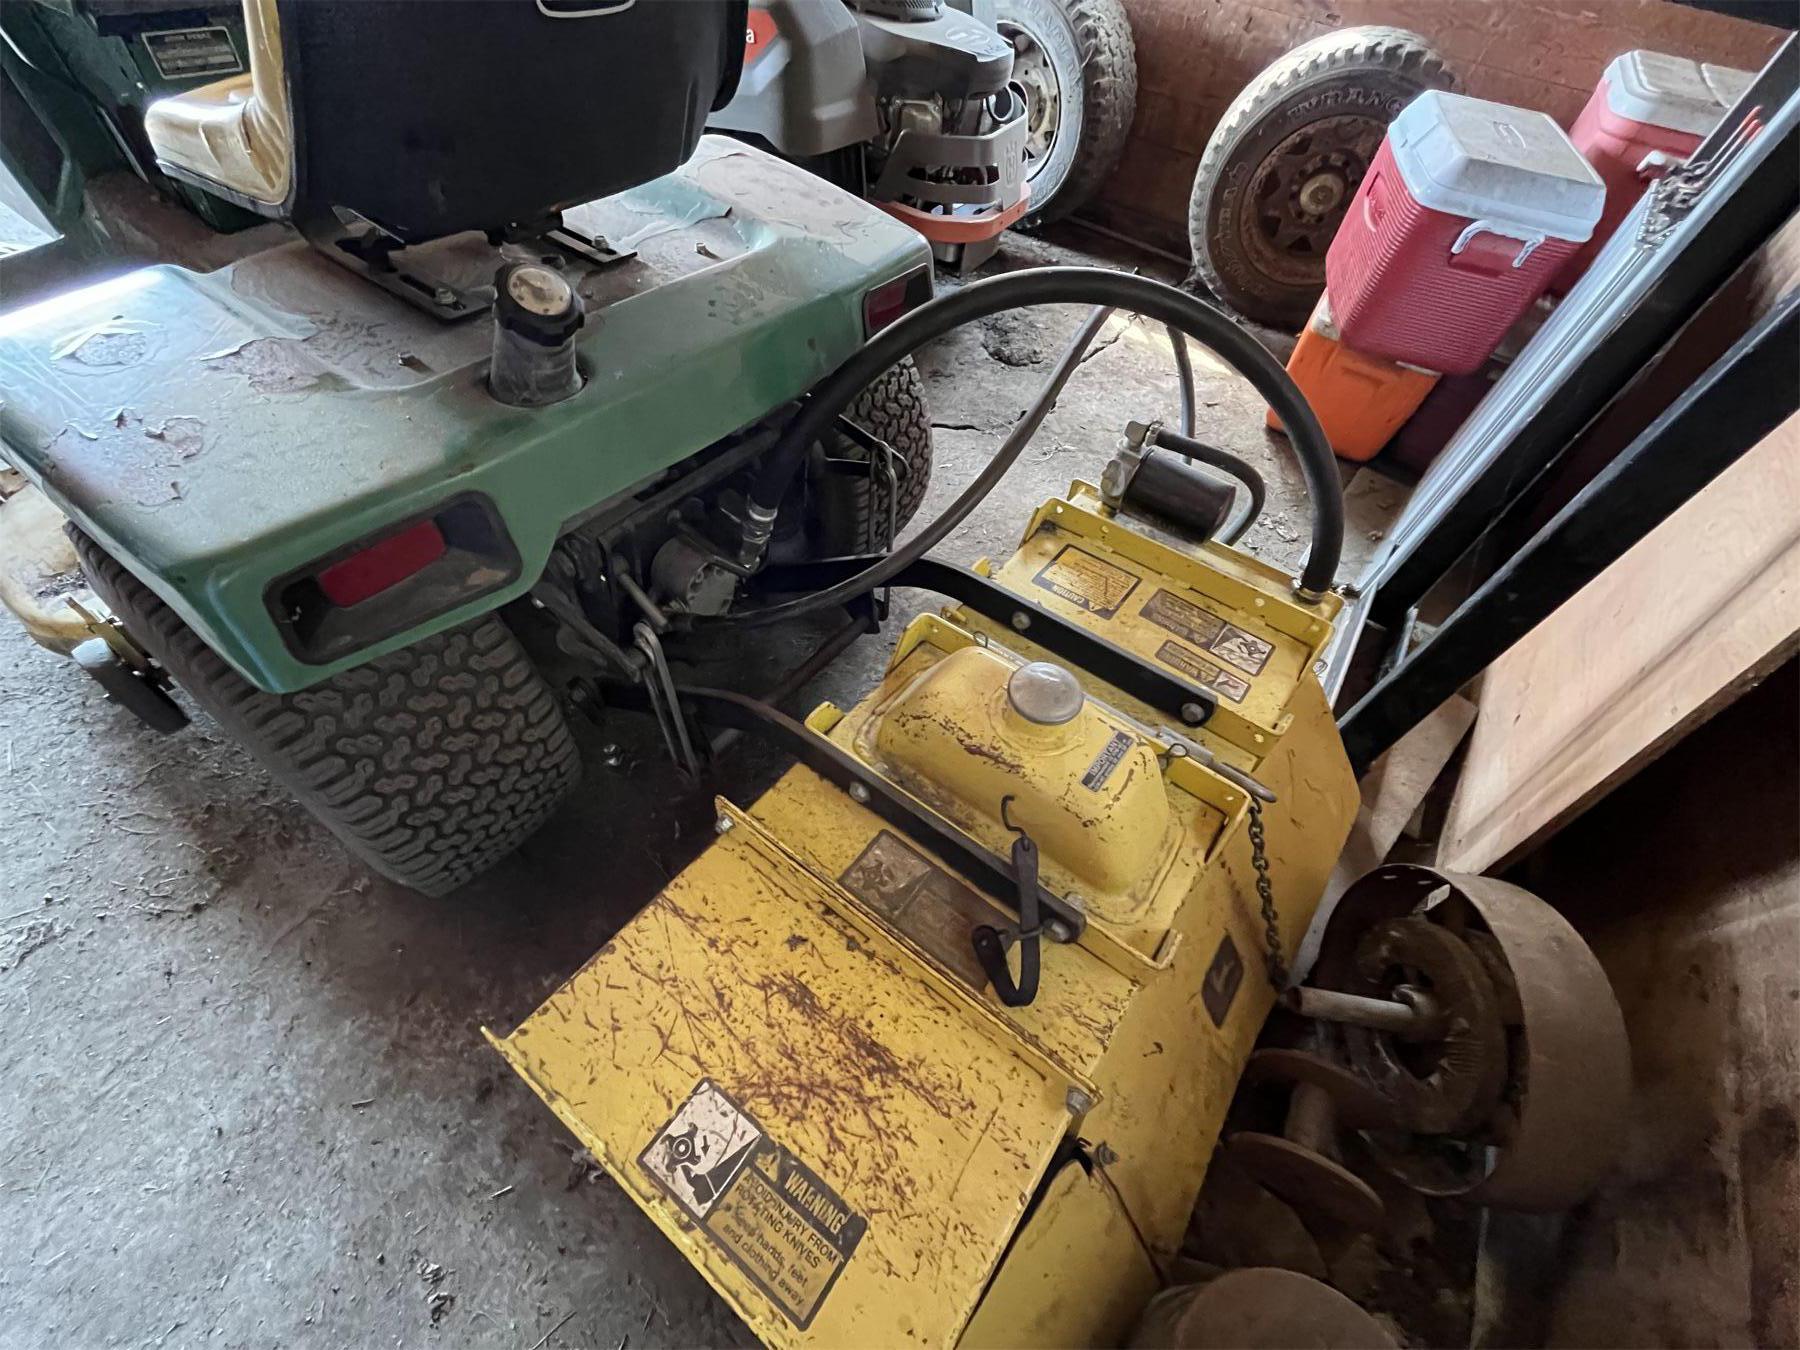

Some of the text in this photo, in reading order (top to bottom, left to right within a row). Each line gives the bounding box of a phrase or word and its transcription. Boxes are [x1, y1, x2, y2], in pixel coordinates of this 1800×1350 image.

[784, 1170, 847, 1235] WARNING
[723, 1224, 806, 1306] and clothing away
[782, 1229, 821, 1269] KNIVES
[807, 1233, 838, 1266] FROM
[788, 1264, 808, 1287] feet
